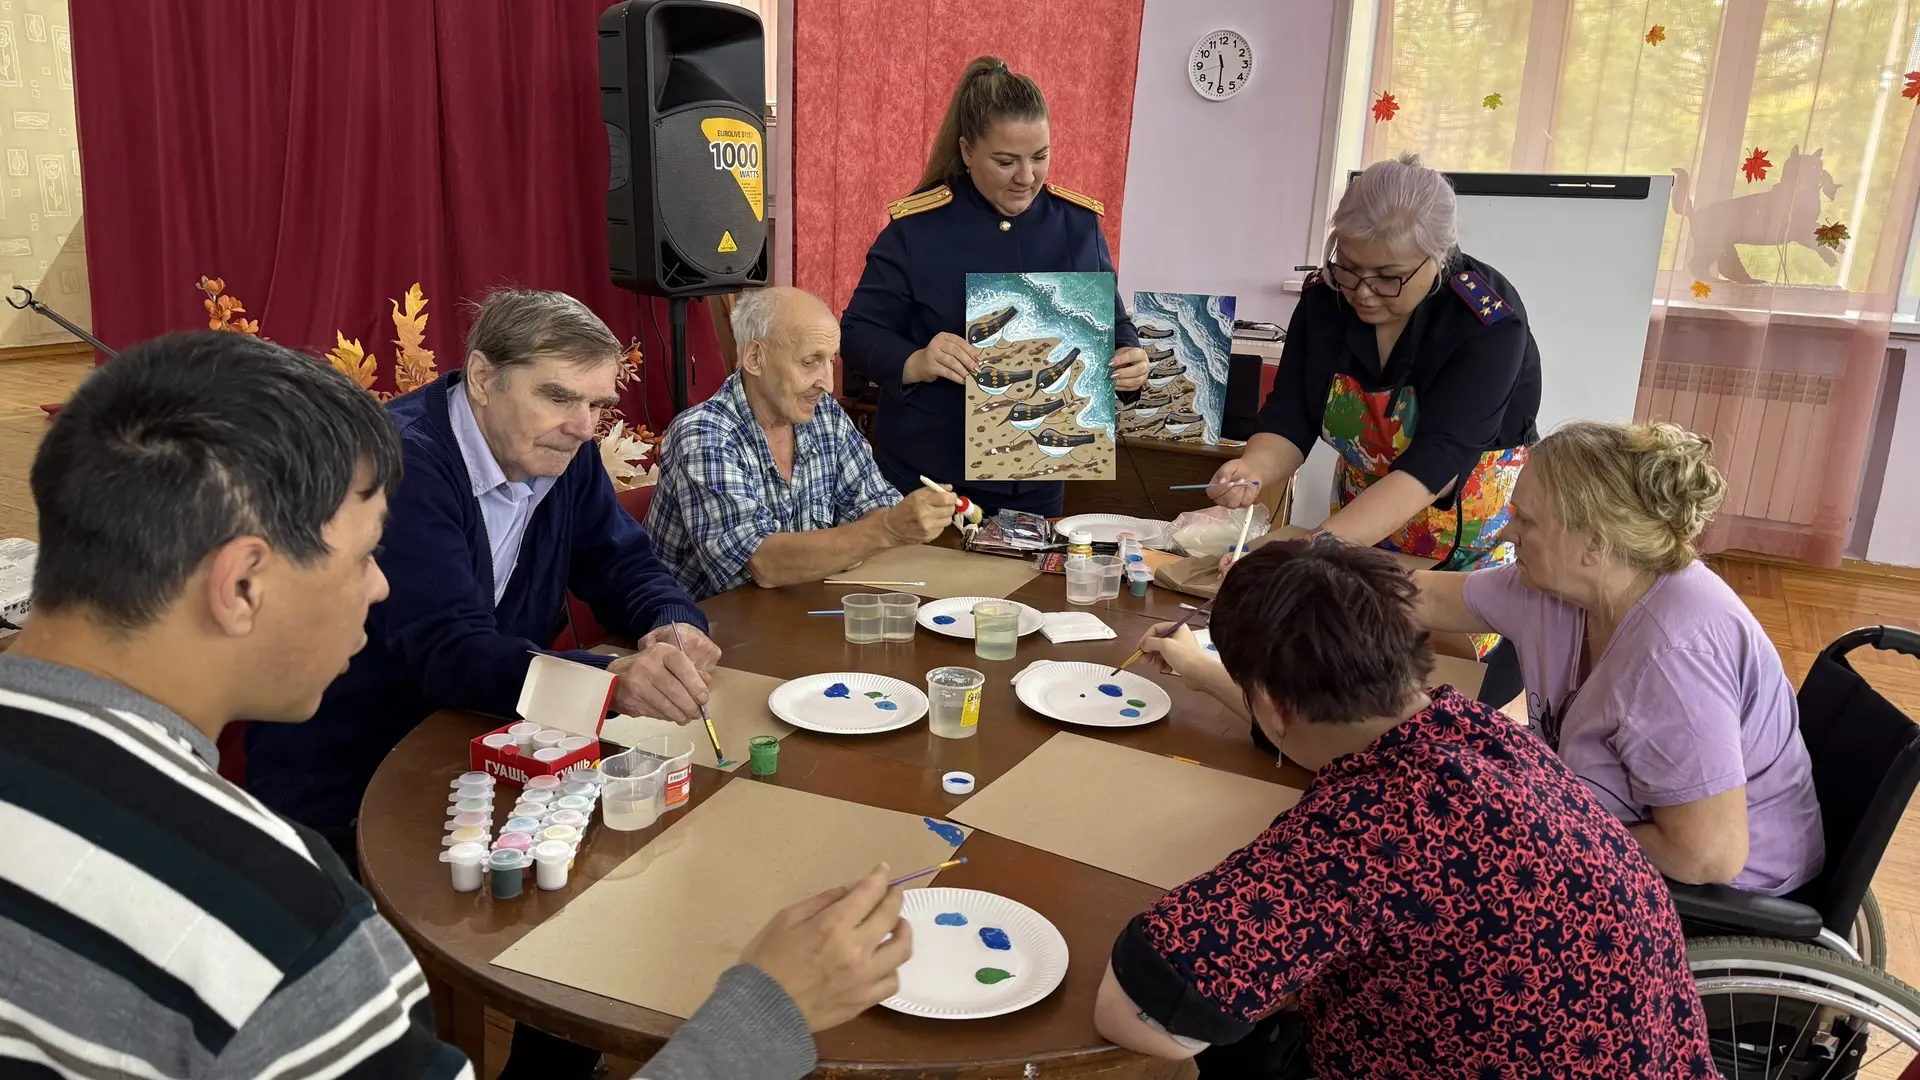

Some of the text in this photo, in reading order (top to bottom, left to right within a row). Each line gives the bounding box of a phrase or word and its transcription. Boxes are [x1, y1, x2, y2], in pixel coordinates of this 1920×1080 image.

[1208, 40, 1217, 49] 11
[1219, 36, 1229, 45] 12
[1200, 49, 1211, 59] 10
[1238, 48, 1246, 57] 2
[1196, 61, 1204, 71] 9
[1241, 60, 1249, 69] 3
[1199, 73, 1206, 82] 8
[1236, 72, 1244, 81] 4
[1207, 81, 1214, 91] 7
[1216, 85, 1224, 94] 6
[1228, 81, 1236, 90] 5
[717, 129, 741, 138] EUROLIVE
[710, 142, 759, 169] 1000
[739, 170, 759, 179] WATTS
[484, 759, 530, 784] ГУАШЬ
